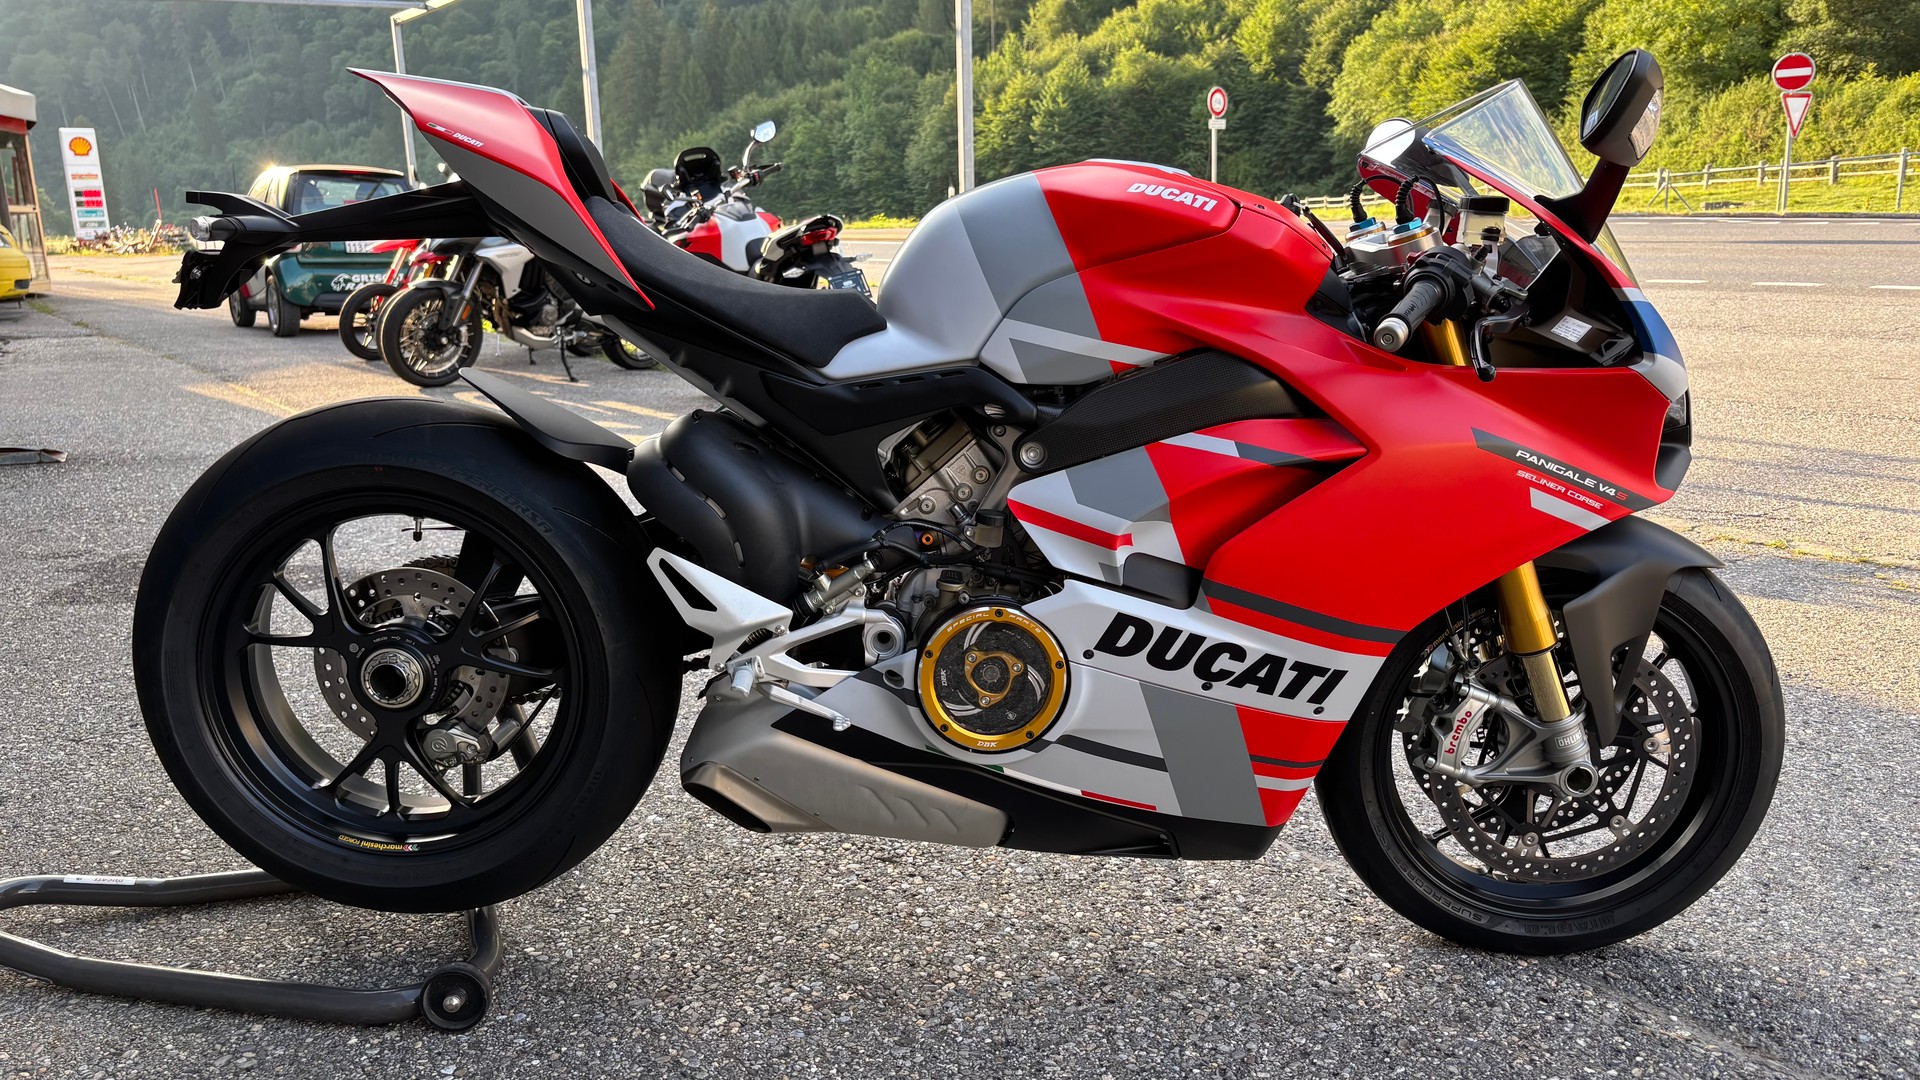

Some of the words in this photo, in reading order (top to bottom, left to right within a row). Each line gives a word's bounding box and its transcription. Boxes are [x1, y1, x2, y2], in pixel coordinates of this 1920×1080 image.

[453, 132, 484, 147] DUCATI
[1126, 182, 1218, 212] DUCATI
[1516, 450, 1597, 488] PANIGALE
[1516, 469, 1566, 493] SELINER
[1567, 489, 1603, 510] CORSE
[946, 612, 990, 633] SPECIAL
[1008, 614, 1042, 634] PARTS
[1093, 611, 1349, 705] DUCATI
[977, 740, 998, 748] DBK
[1444, 710, 1473, 755] brembo
[338, 834, 360, 845] FORGED
[360, 840, 403, 851] marchesini
[1392, 855, 1483, 922] SUPERCORSA
[1523, 911, 1615, 936] DIABLO
